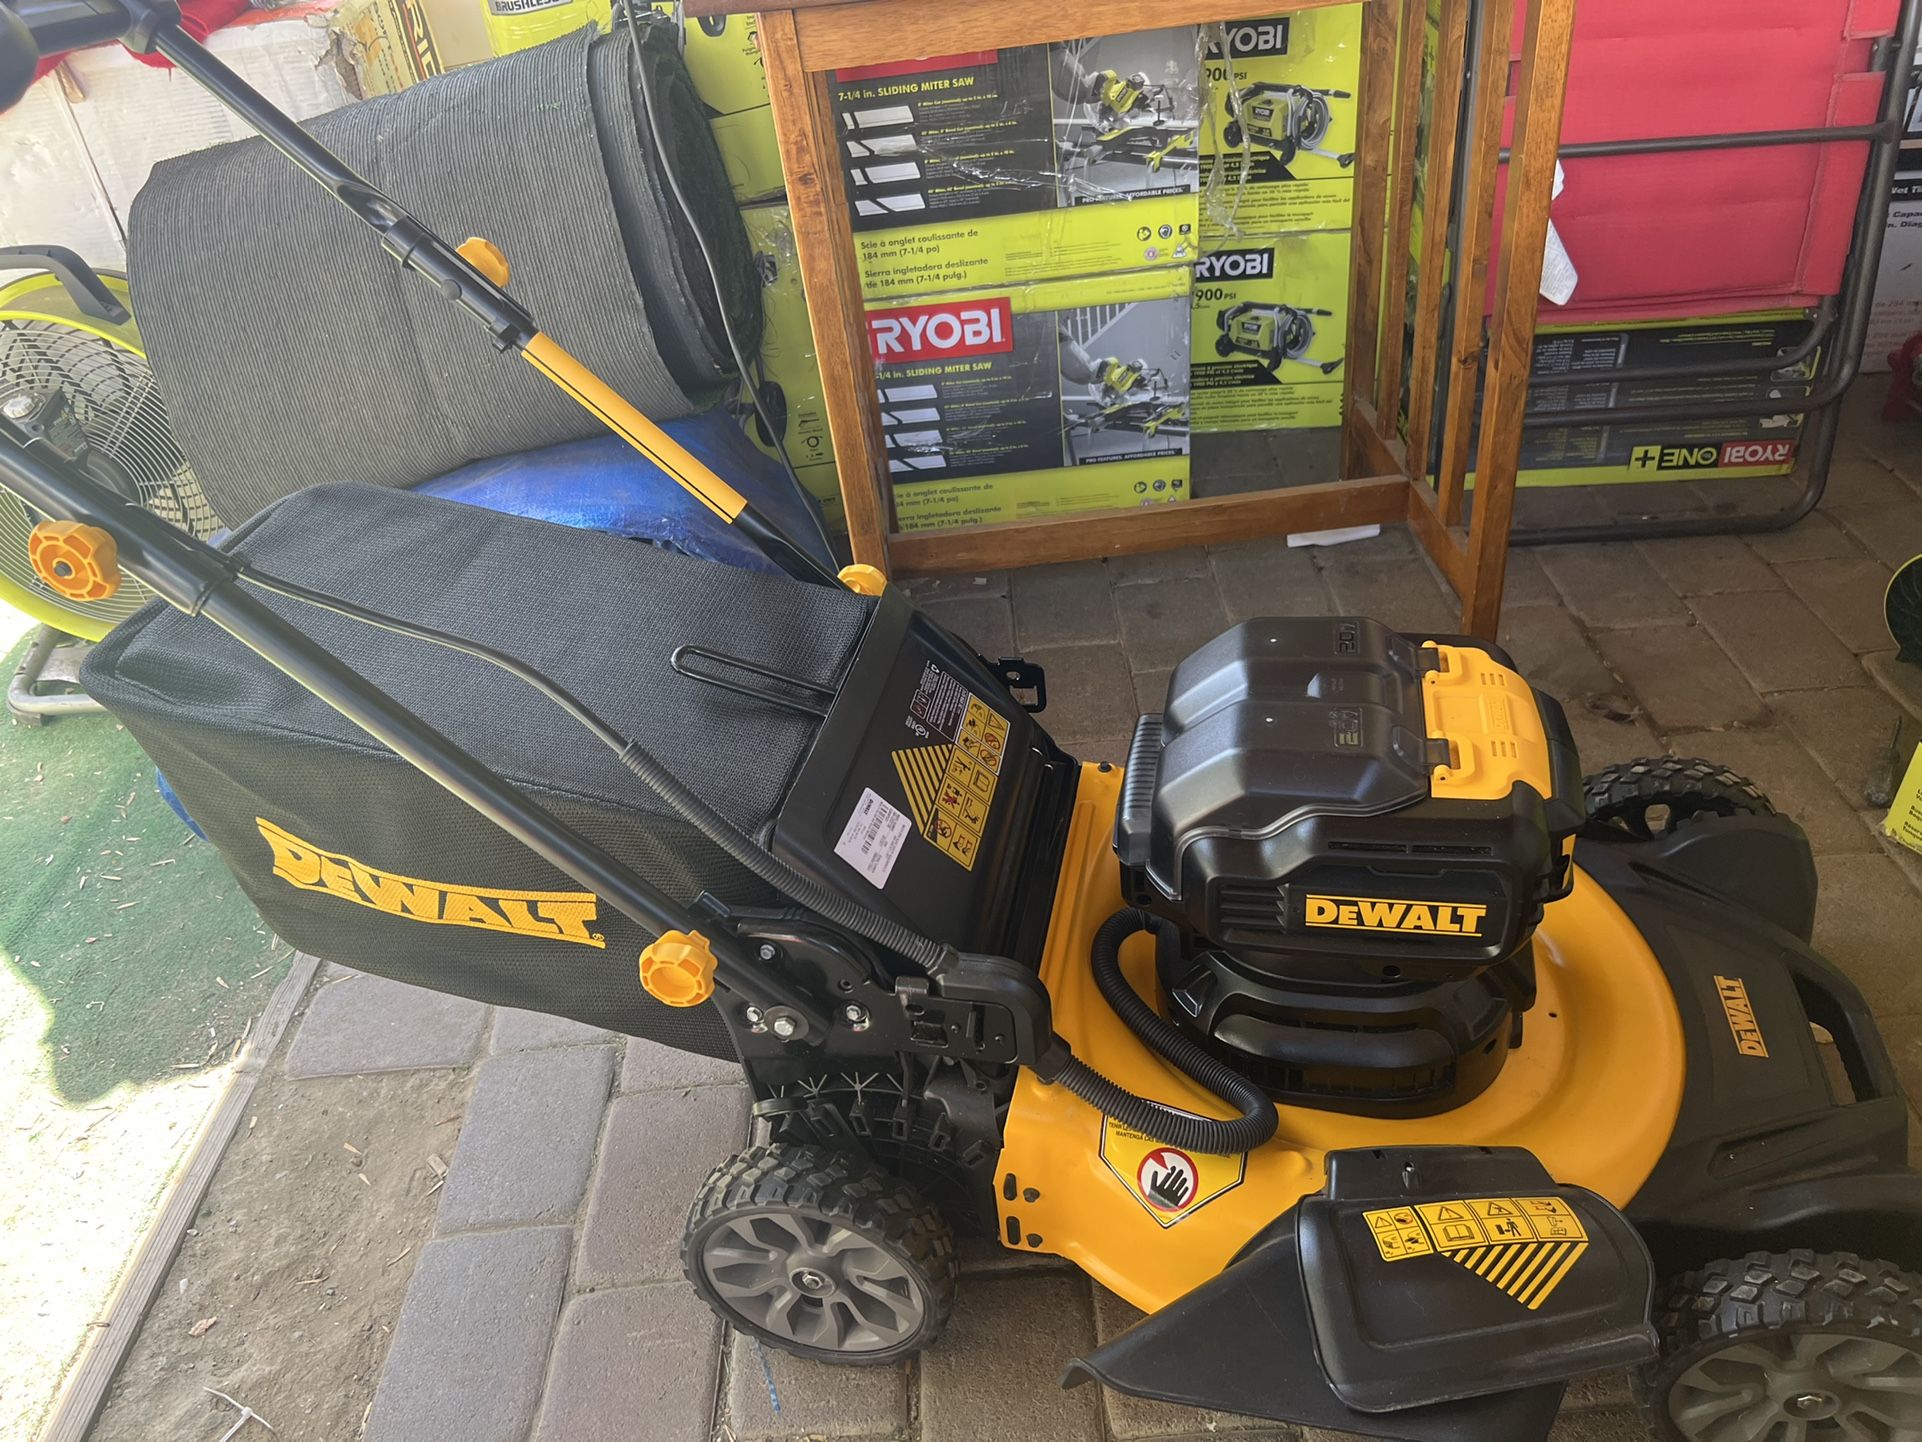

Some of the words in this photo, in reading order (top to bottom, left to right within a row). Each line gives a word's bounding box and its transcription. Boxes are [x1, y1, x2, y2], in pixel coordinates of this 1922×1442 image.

[838, 90, 861, 101] 7-1/4
[863, 89, 876, 98] in.
[878, 83, 919, 97] SLIDING
[921, 79, 950, 92] MITER
[953, 76, 975, 88] SAW
[861, 241, 877, 250] Scie
[880, 239, 886, 247] à
[889, 237, 915, 247] onglet
[918, 232, 965, 244] coulissante
[967, 229, 978, 237] de
[862, 252, 878, 261] 184
[881, 250, 897, 258] mm
[900, 246, 924, 257] (7-1/4
[926, 245, 940, 254] po)
[865, 268, 891, 278] Sierra
[893, 263, 943, 276] ingletadora
[945, 258, 988, 269] deslizante
[1195, 253, 1268, 278] RYOBI
[866, 281, 878, 289] de
[880, 279, 896, 287] 184
[897, 277, 914, 285] mm
[917, 273, 941, 285] (7-1/4
[943, 271, 967, 282] pulg.)
[1192, 288, 1223, 301] 900
[871, 308, 1002, 354] RYOBI
[876, 370, 891, 380] -1/4
[893, 370, 904, 378] in.
[906, 366, 943, 377] SLIDING
[944, 363, 971, 374] MITER
[972, 361, 993, 371] SAW
[1724, 445, 1790, 463] RYOBI
[913, 488, 938, 498] onglet
[939, 485, 981, 495] coulissante
[983, 482, 993, 490] de
[946, 496, 959, 504] po)
[916, 510, 961, 520] ingletadora
[963, 506, 1002, 516] deslizante
[905, 522, 919, 530] 184
[921, 521, 935, 529] mm
[1115, 1130, 1143, 1141] MANTENGA
